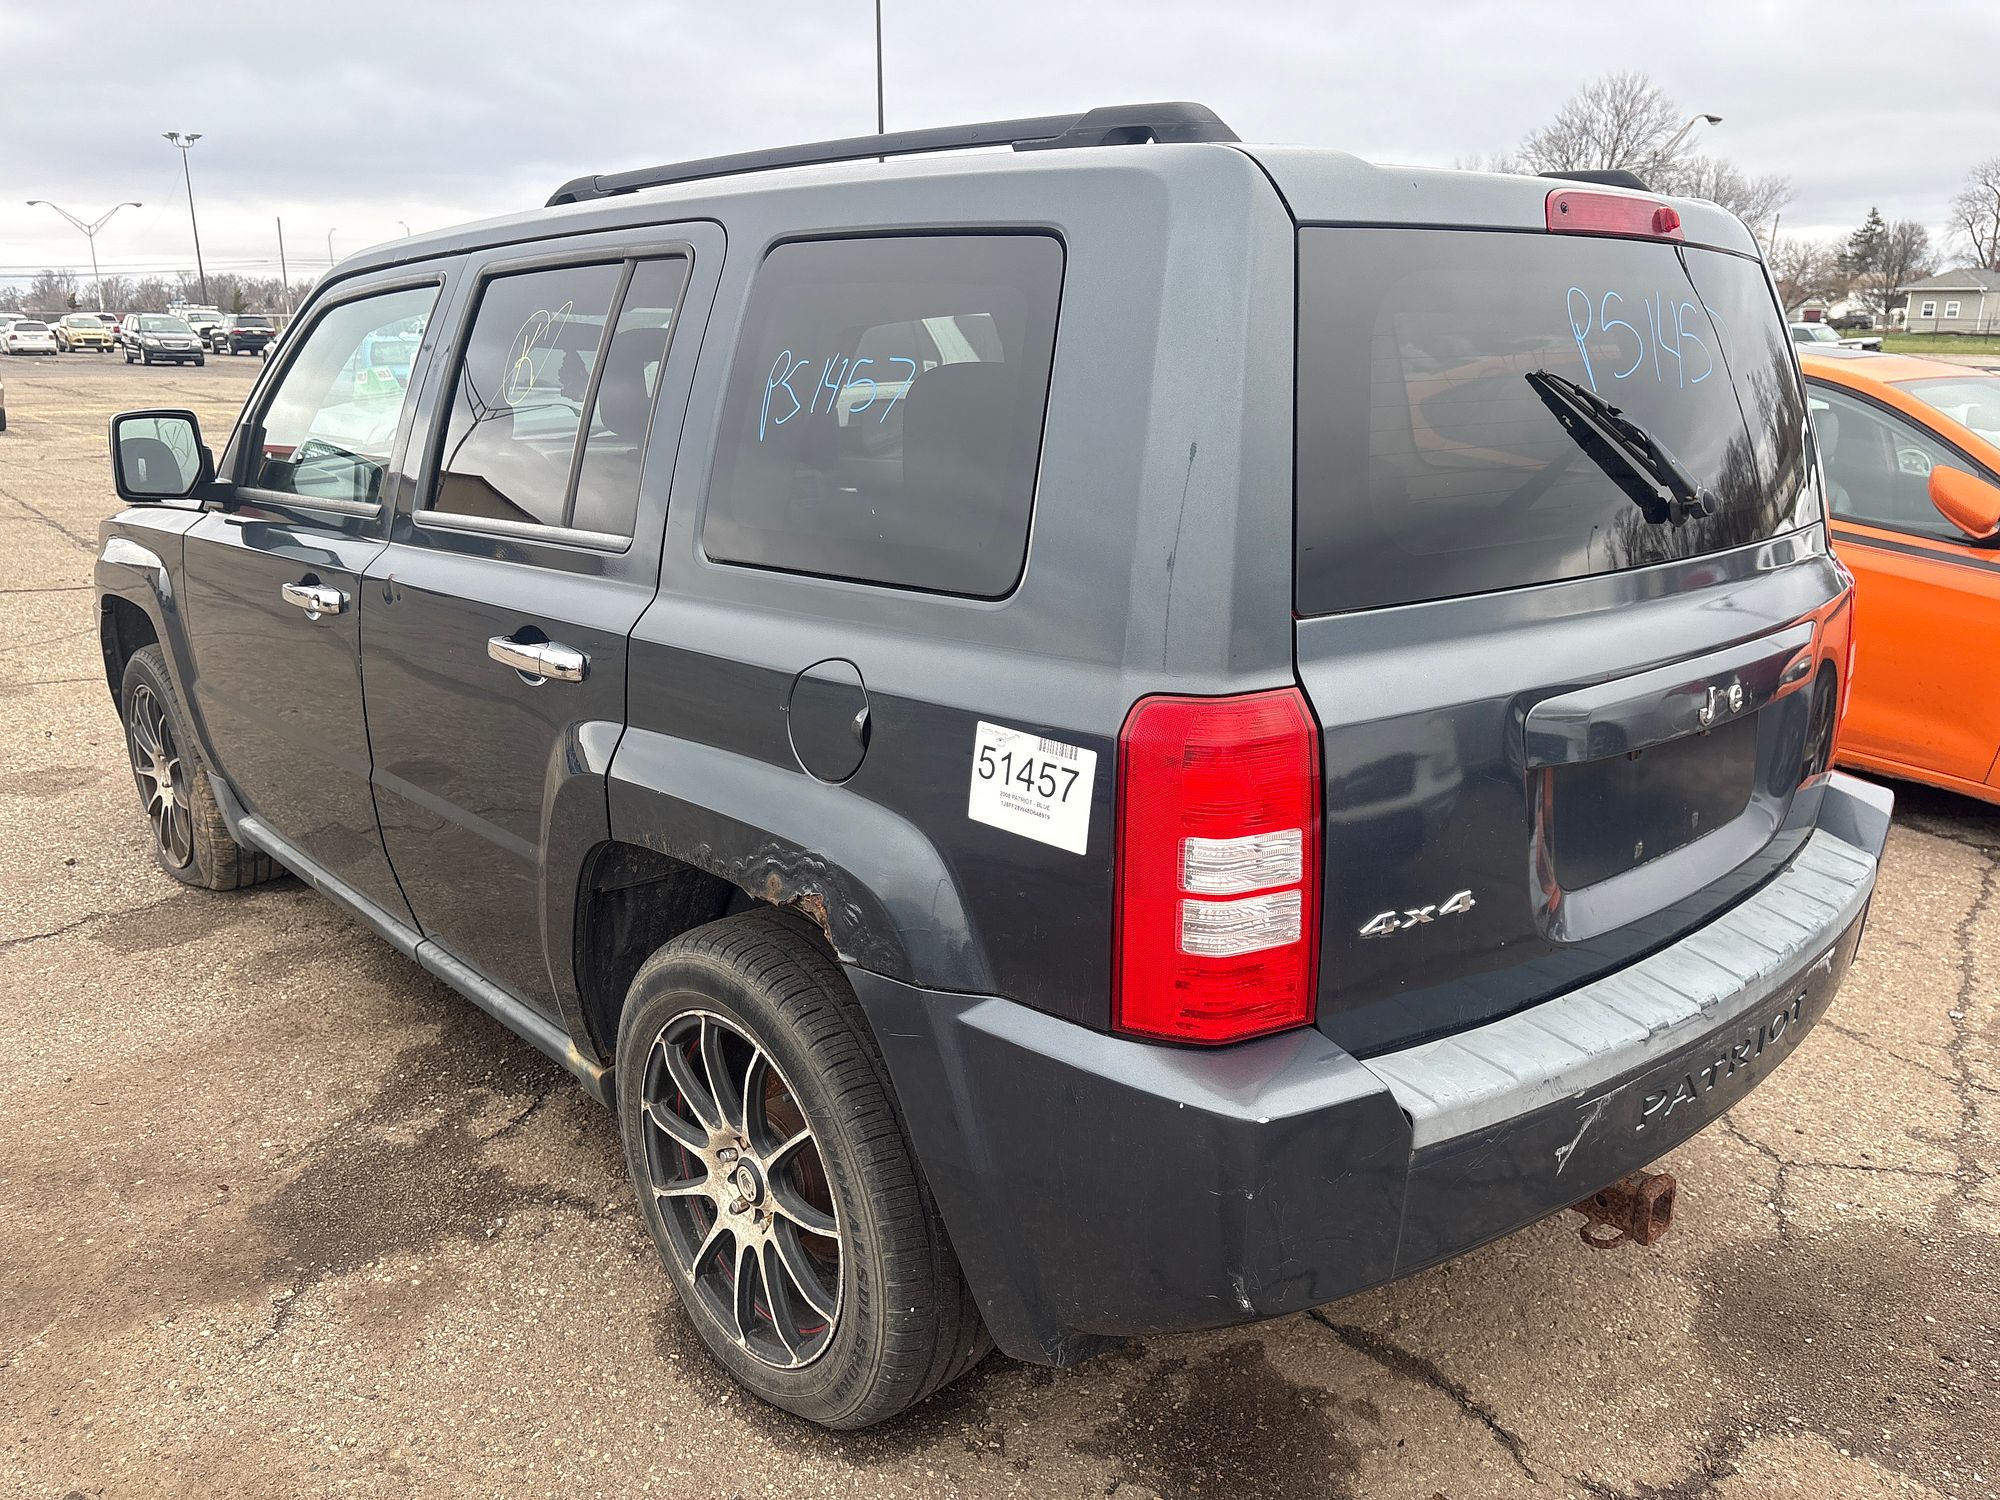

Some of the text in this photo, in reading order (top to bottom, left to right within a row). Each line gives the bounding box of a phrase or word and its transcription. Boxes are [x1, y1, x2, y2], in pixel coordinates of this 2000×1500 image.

[978, 745, 1080, 803] 51457
[1011, 793, 1032, 806] PATRIOT
[1358, 888, 1477, 938] 4x4
[1635, 988, 1809, 1132] PATRIOT
